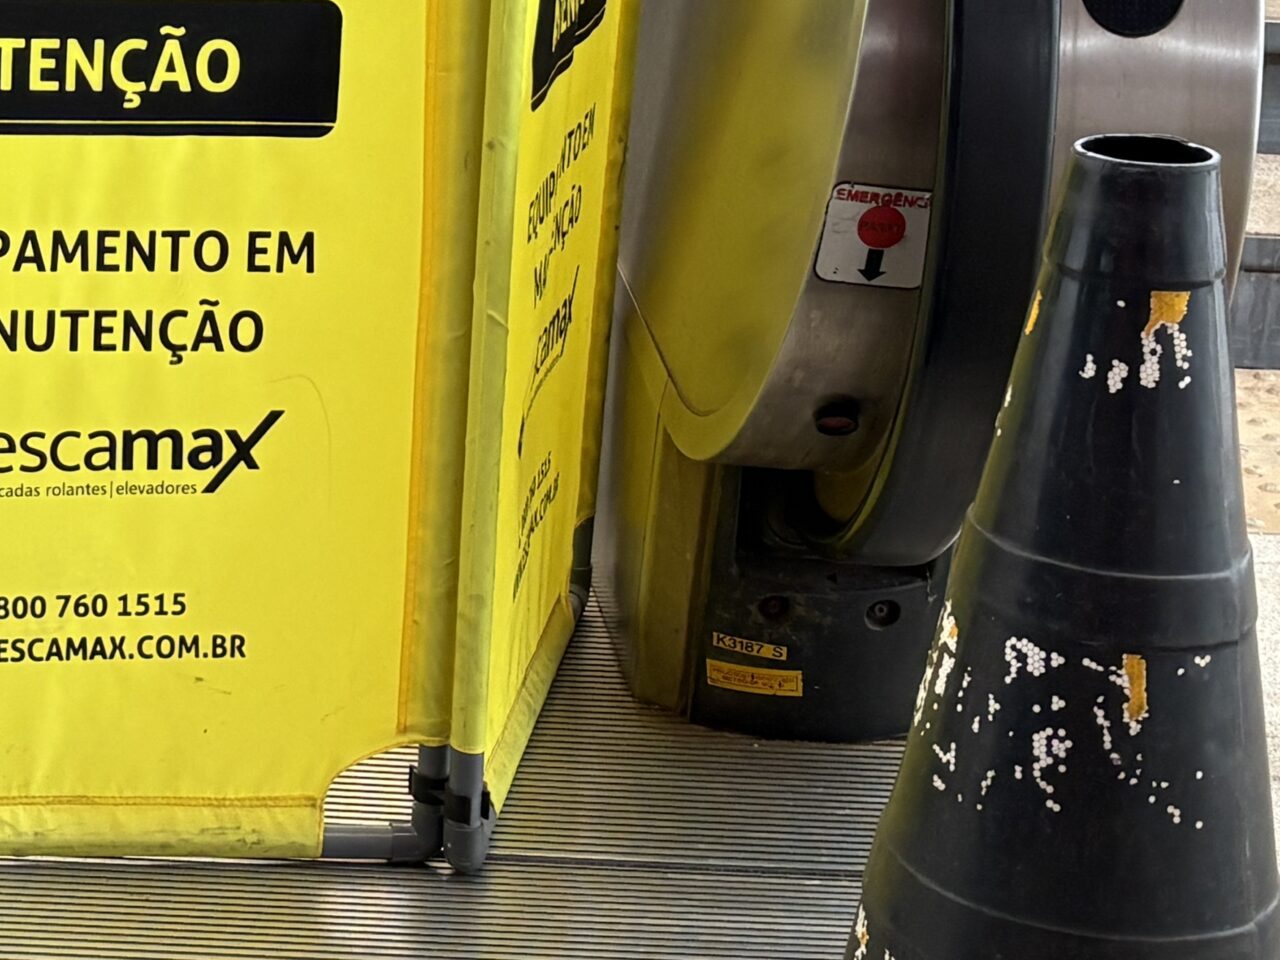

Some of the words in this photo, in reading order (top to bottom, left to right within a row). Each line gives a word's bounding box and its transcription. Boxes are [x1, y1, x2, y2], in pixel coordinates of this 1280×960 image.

[246, 230, 316, 274] EM
[55, 593, 108, 619] 760
[117, 592, 187, 617] 1515
[716, 633, 764, 654] K3187
[772, 646, 784, 658] S
